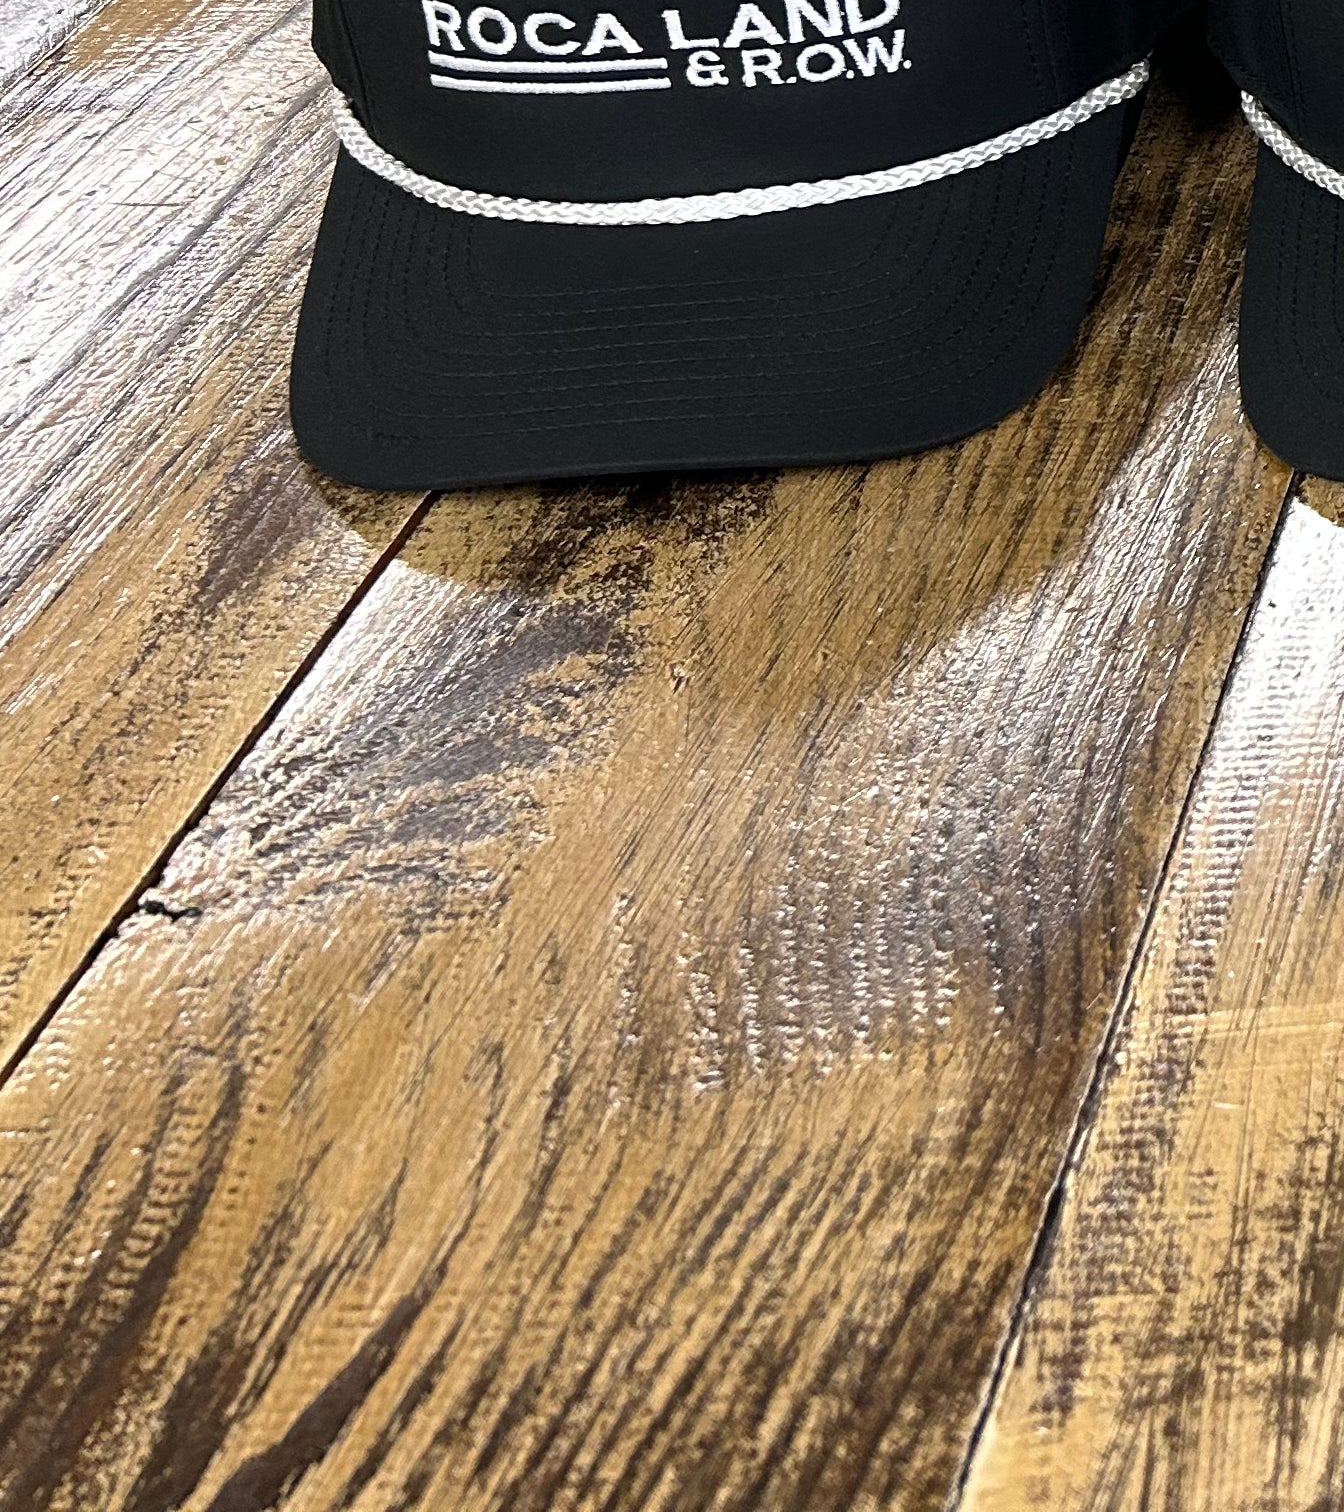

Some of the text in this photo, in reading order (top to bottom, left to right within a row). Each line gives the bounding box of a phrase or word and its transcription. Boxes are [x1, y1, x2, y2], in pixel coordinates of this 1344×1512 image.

[422, 0, 643, 56] ROCA
[686, 29, 912, 88] & R.O.W.
